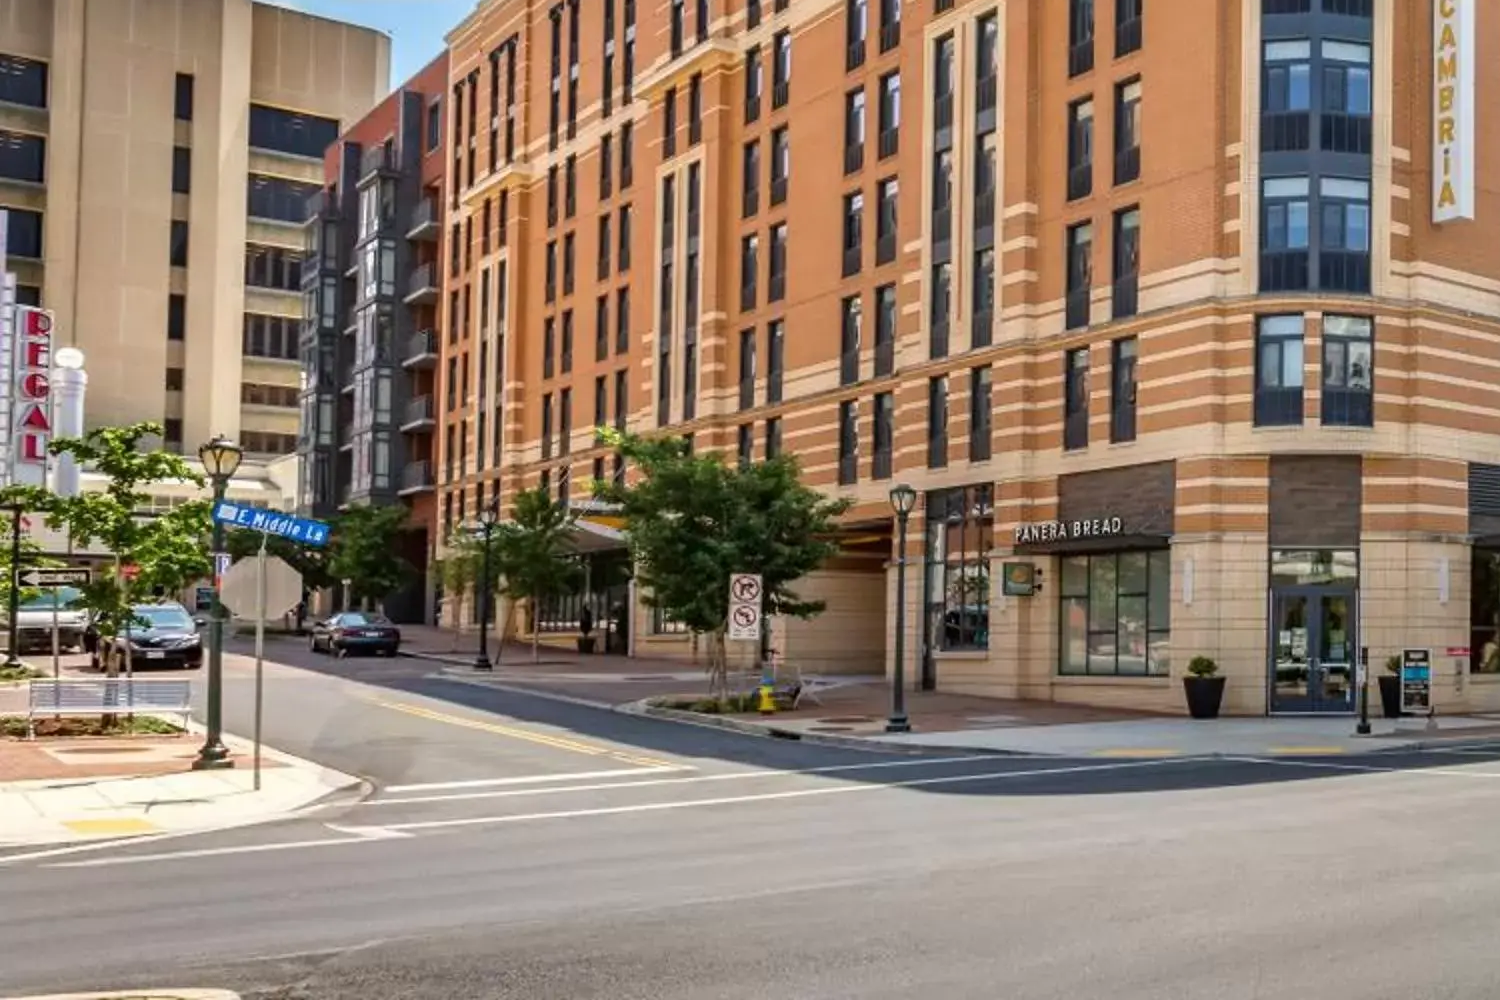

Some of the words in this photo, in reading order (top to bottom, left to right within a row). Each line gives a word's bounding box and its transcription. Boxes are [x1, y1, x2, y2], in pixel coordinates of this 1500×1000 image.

[23, 311, 52, 460] REGAL
[237, 509, 249, 523] E
[252, 513, 301, 537] Middle
[1015, 523, 1067, 543] PANERA
[1073, 517, 1121, 537] BREAD
